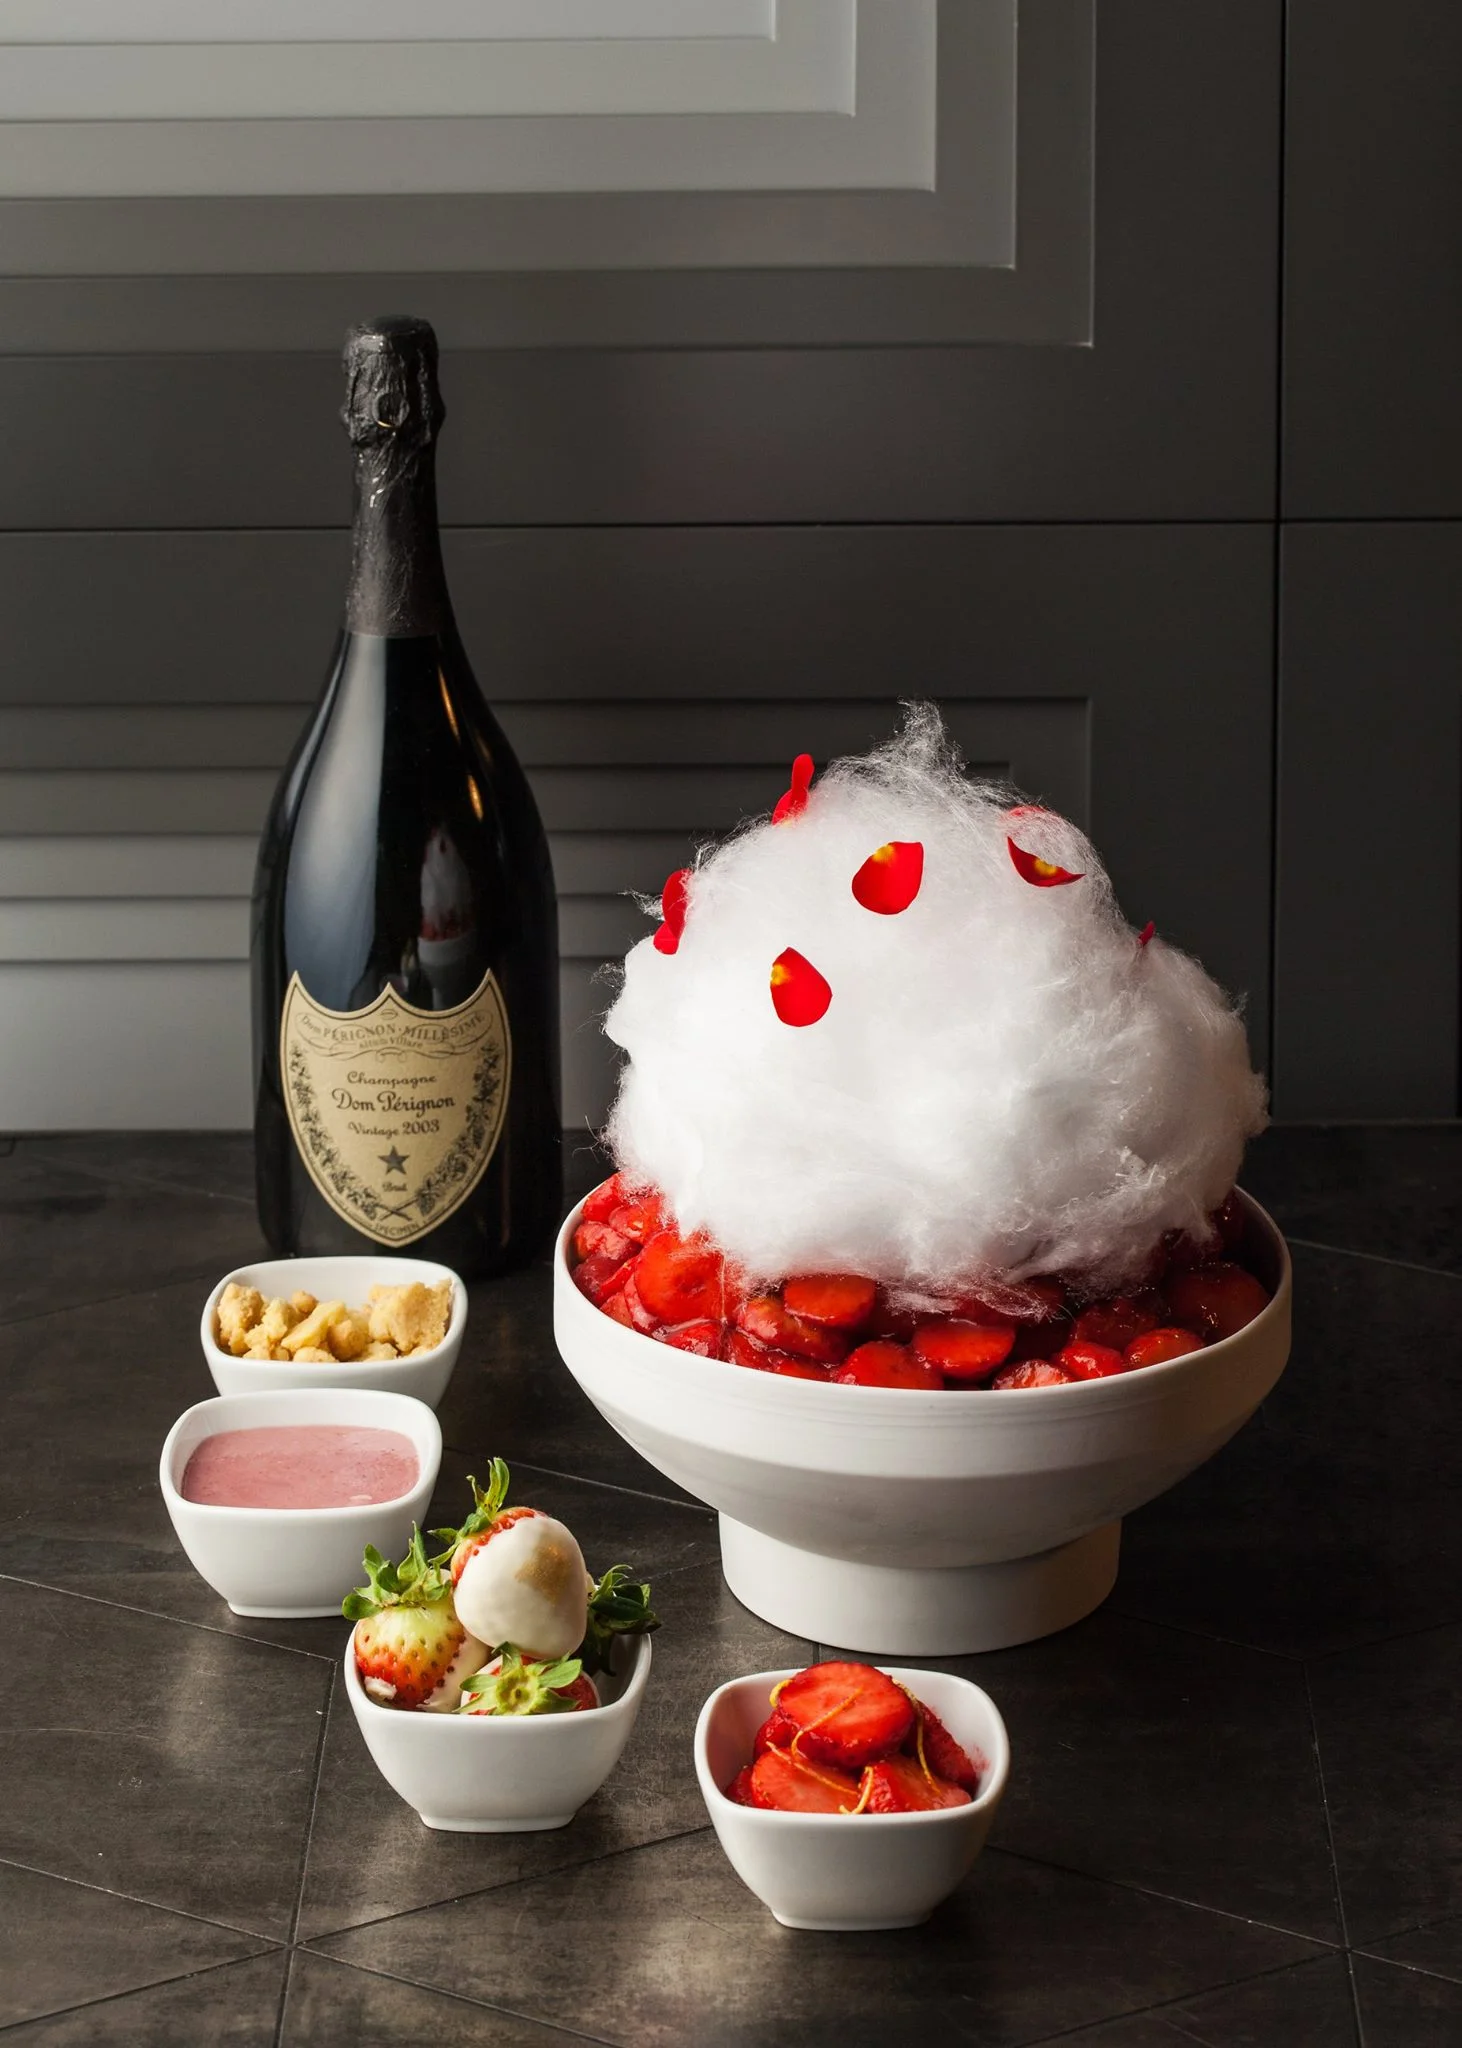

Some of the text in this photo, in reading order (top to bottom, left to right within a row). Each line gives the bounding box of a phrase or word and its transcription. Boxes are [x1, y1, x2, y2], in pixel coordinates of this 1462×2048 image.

[346, 1070, 437, 1089] Champagne
[331, 1087, 456, 1118] Dom Pérignon
[347, 1118, 440, 1140] Vintage 2003
